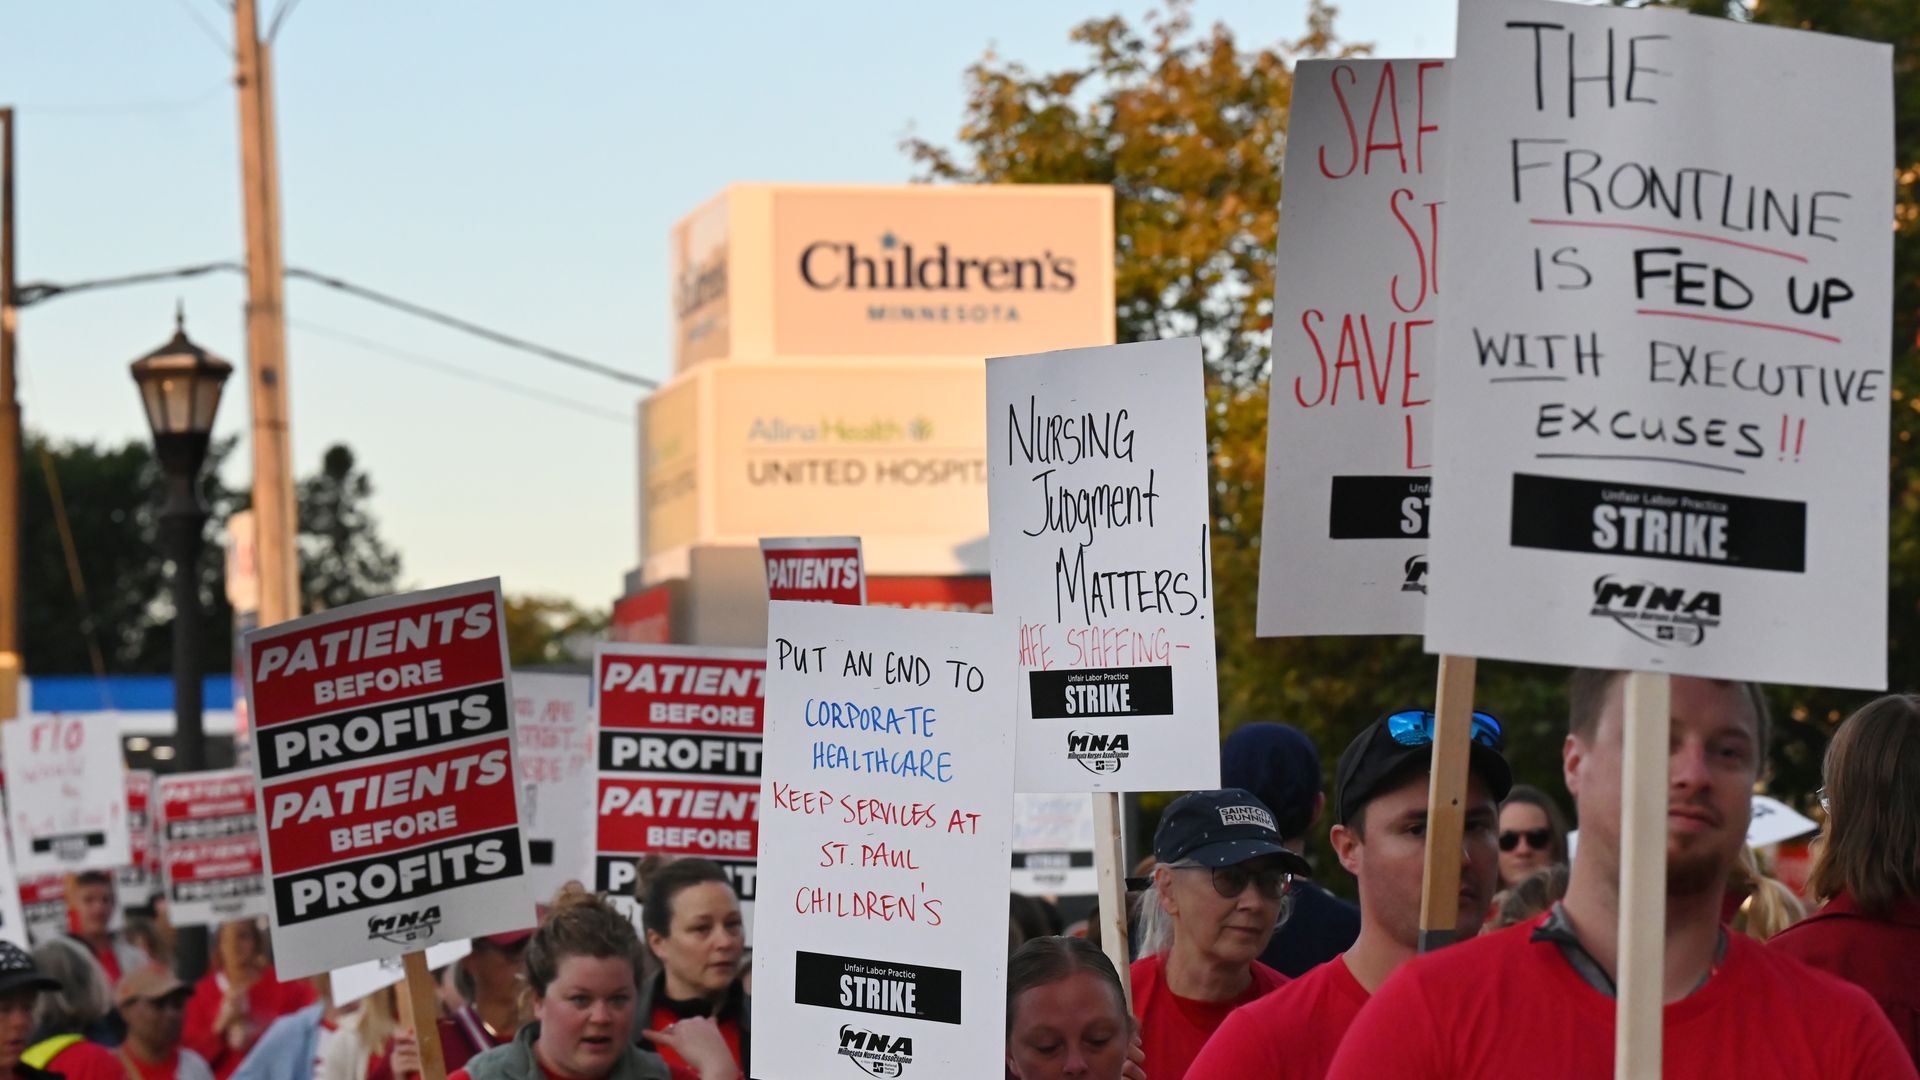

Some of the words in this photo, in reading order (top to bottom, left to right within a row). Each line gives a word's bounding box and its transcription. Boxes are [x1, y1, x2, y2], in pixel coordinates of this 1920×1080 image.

[1505, 22, 1673, 119] THE
[1511, 138, 1853, 243] FRONTLINE
[799, 236, 1076, 292] Children's
[1534, 246, 1593, 293] IS
[1633, 246, 1754, 311] FED
[1787, 275, 1855, 320] UP
[867, 305, 1020, 322] MINNESOTA
[1294, 309, 1435, 408] SAVE
[1472, 326, 1604, 378] WITH
[1649, 339, 1885, 407] EXECUTIVE
[1008, 395, 1134, 466] NURSING
[747, 458, 867, 486] UNITED
[876, 458, 987, 486] HOSPIT
[1601, 488, 1640, 505] Unfair
[1642, 492, 1677, 508] Labor
[1680, 495, 1729, 513] Practice
[1592, 504, 1729, 560] STRIKE
[768, 557, 859, 590] PATIENTS
[1056, 523, 1207, 625] MATTERS!
[1594, 582, 1721, 617] MNA
[256, 602, 494, 683] PATIENTS
[1019, 623, 1054, 672] AFE
[313, 659, 444, 706] BEFORE
[775, 637, 827, 674] PUT
[843, 649, 873, 678] AN
[885, 651, 931, 687] END
[946, 660, 984, 693] TO
[1067, 674, 1085, 683] Unfair
[1085, 673, 1103, 682] Labor
[1104, 672, 1129, 681] Practice
[649, 703, 756, 726] BEFORE
[805, 698, 937, 738] CORPORATE
[1065, 683, 1131, 715] STRIKE
[274, 694, 492, 769] PROFITS
[1068, 734, 1129, 752] MNA
[813, 741, 953, 783] HEALTHCARE
[270, 749, 508, 831] PATIENTS
[773, 781, 834, 815] KEEP
[840, 795, 937, 829] SERVICES
[947, 809, 982, 835] AT
[1221, 807, 1253, 816] SAINT
[330, 805, 458, 853] BEFORE
[646, 826, 751, 850] BEFORE
[1225, 814, 1274, 828] RUNNING
[291, 838, 507, 917] PROFITS
[861, 842, 920, 870] PAUL
[795, 881, 943, 927] CHILDREN'S
[844, 963, 865, 973] Unfair
[866, 966, 887, 976] Labor
[887, 968, 916, 979] Practice
[839, 974, 917, 1014] STRIKE
[839, 1029, 913, 1057] MNA
[863, 1051, 881, 1060] Nurses
[881, 1053, 913, 1064] Association
